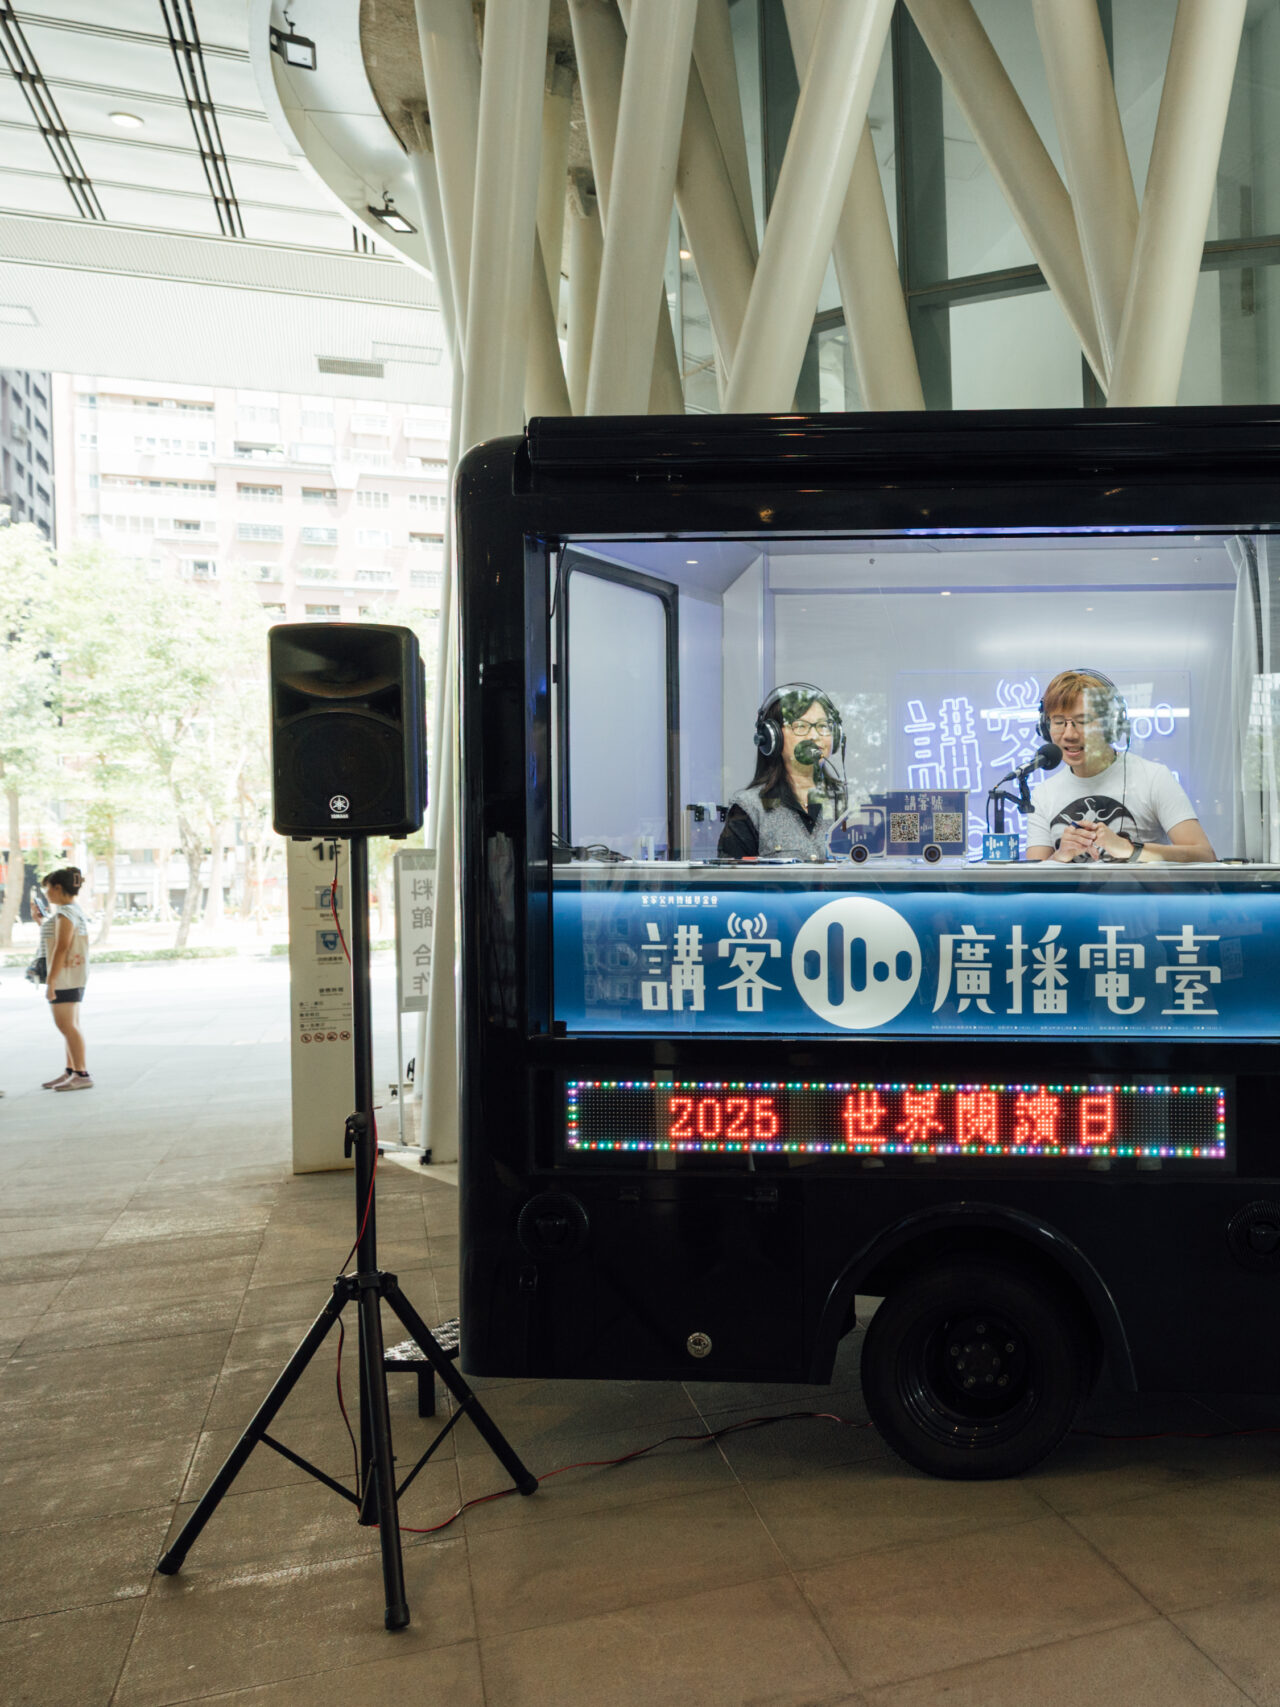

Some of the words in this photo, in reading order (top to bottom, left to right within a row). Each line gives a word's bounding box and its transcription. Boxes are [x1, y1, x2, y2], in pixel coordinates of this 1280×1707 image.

[313, 842, 341, 861] 1F
[641, 912, 782, 1012] 講客
[931, 924, 1222, 1015] 廣播電臺
[670, 1098, 778, 1138] 2025
